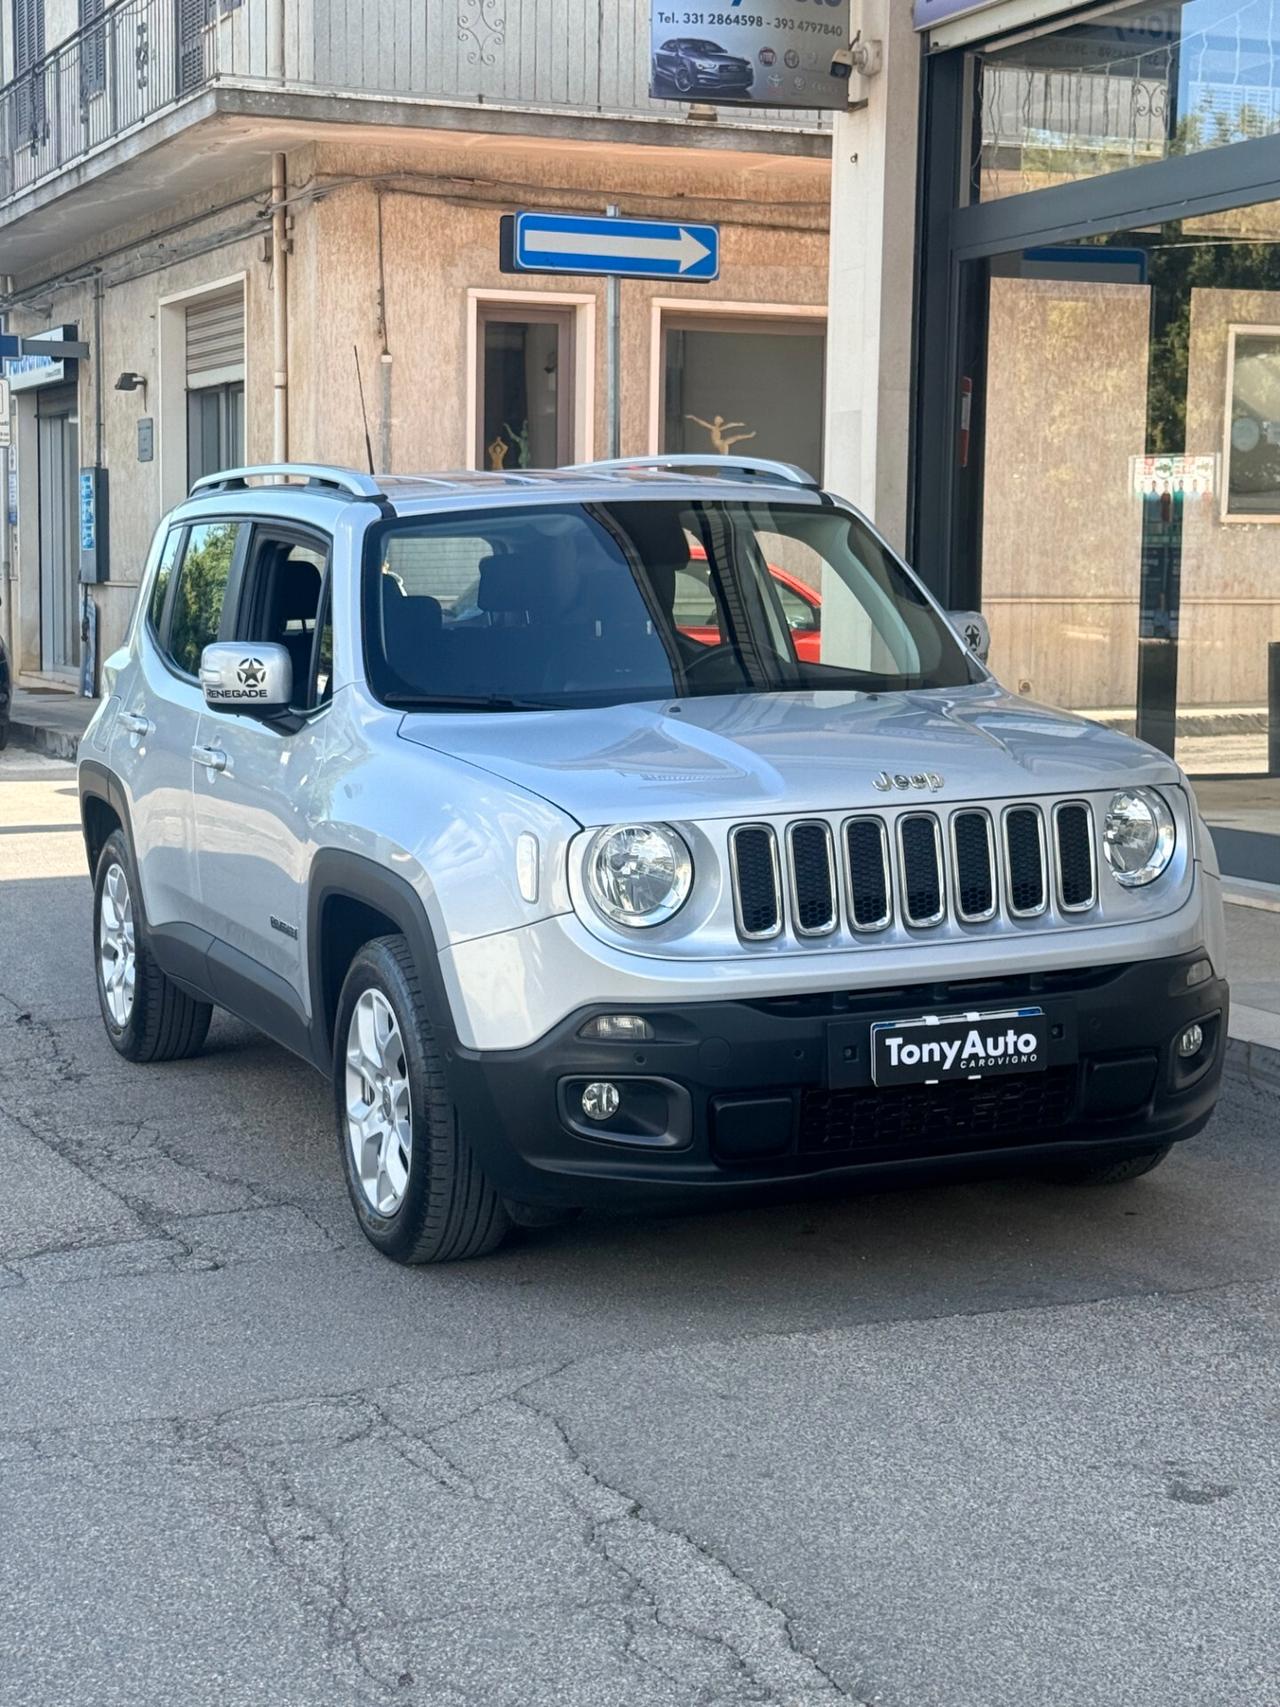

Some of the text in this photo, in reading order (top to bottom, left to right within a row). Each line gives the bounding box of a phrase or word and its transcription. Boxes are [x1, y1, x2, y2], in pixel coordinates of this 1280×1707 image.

[658, 12, 679, 24] Tel.
[683, 13, 704, 25] 331
[708, 13, 763, 27] 2864598
[774, 18, 794, 30] 393
[798, 22, 842, 36] 4797840
[207, 689, 268, 698] RENEGADE
[872, 771, 944, 793] Jeep
[960, 1054, 1037, 1069] CAROVIGNO
